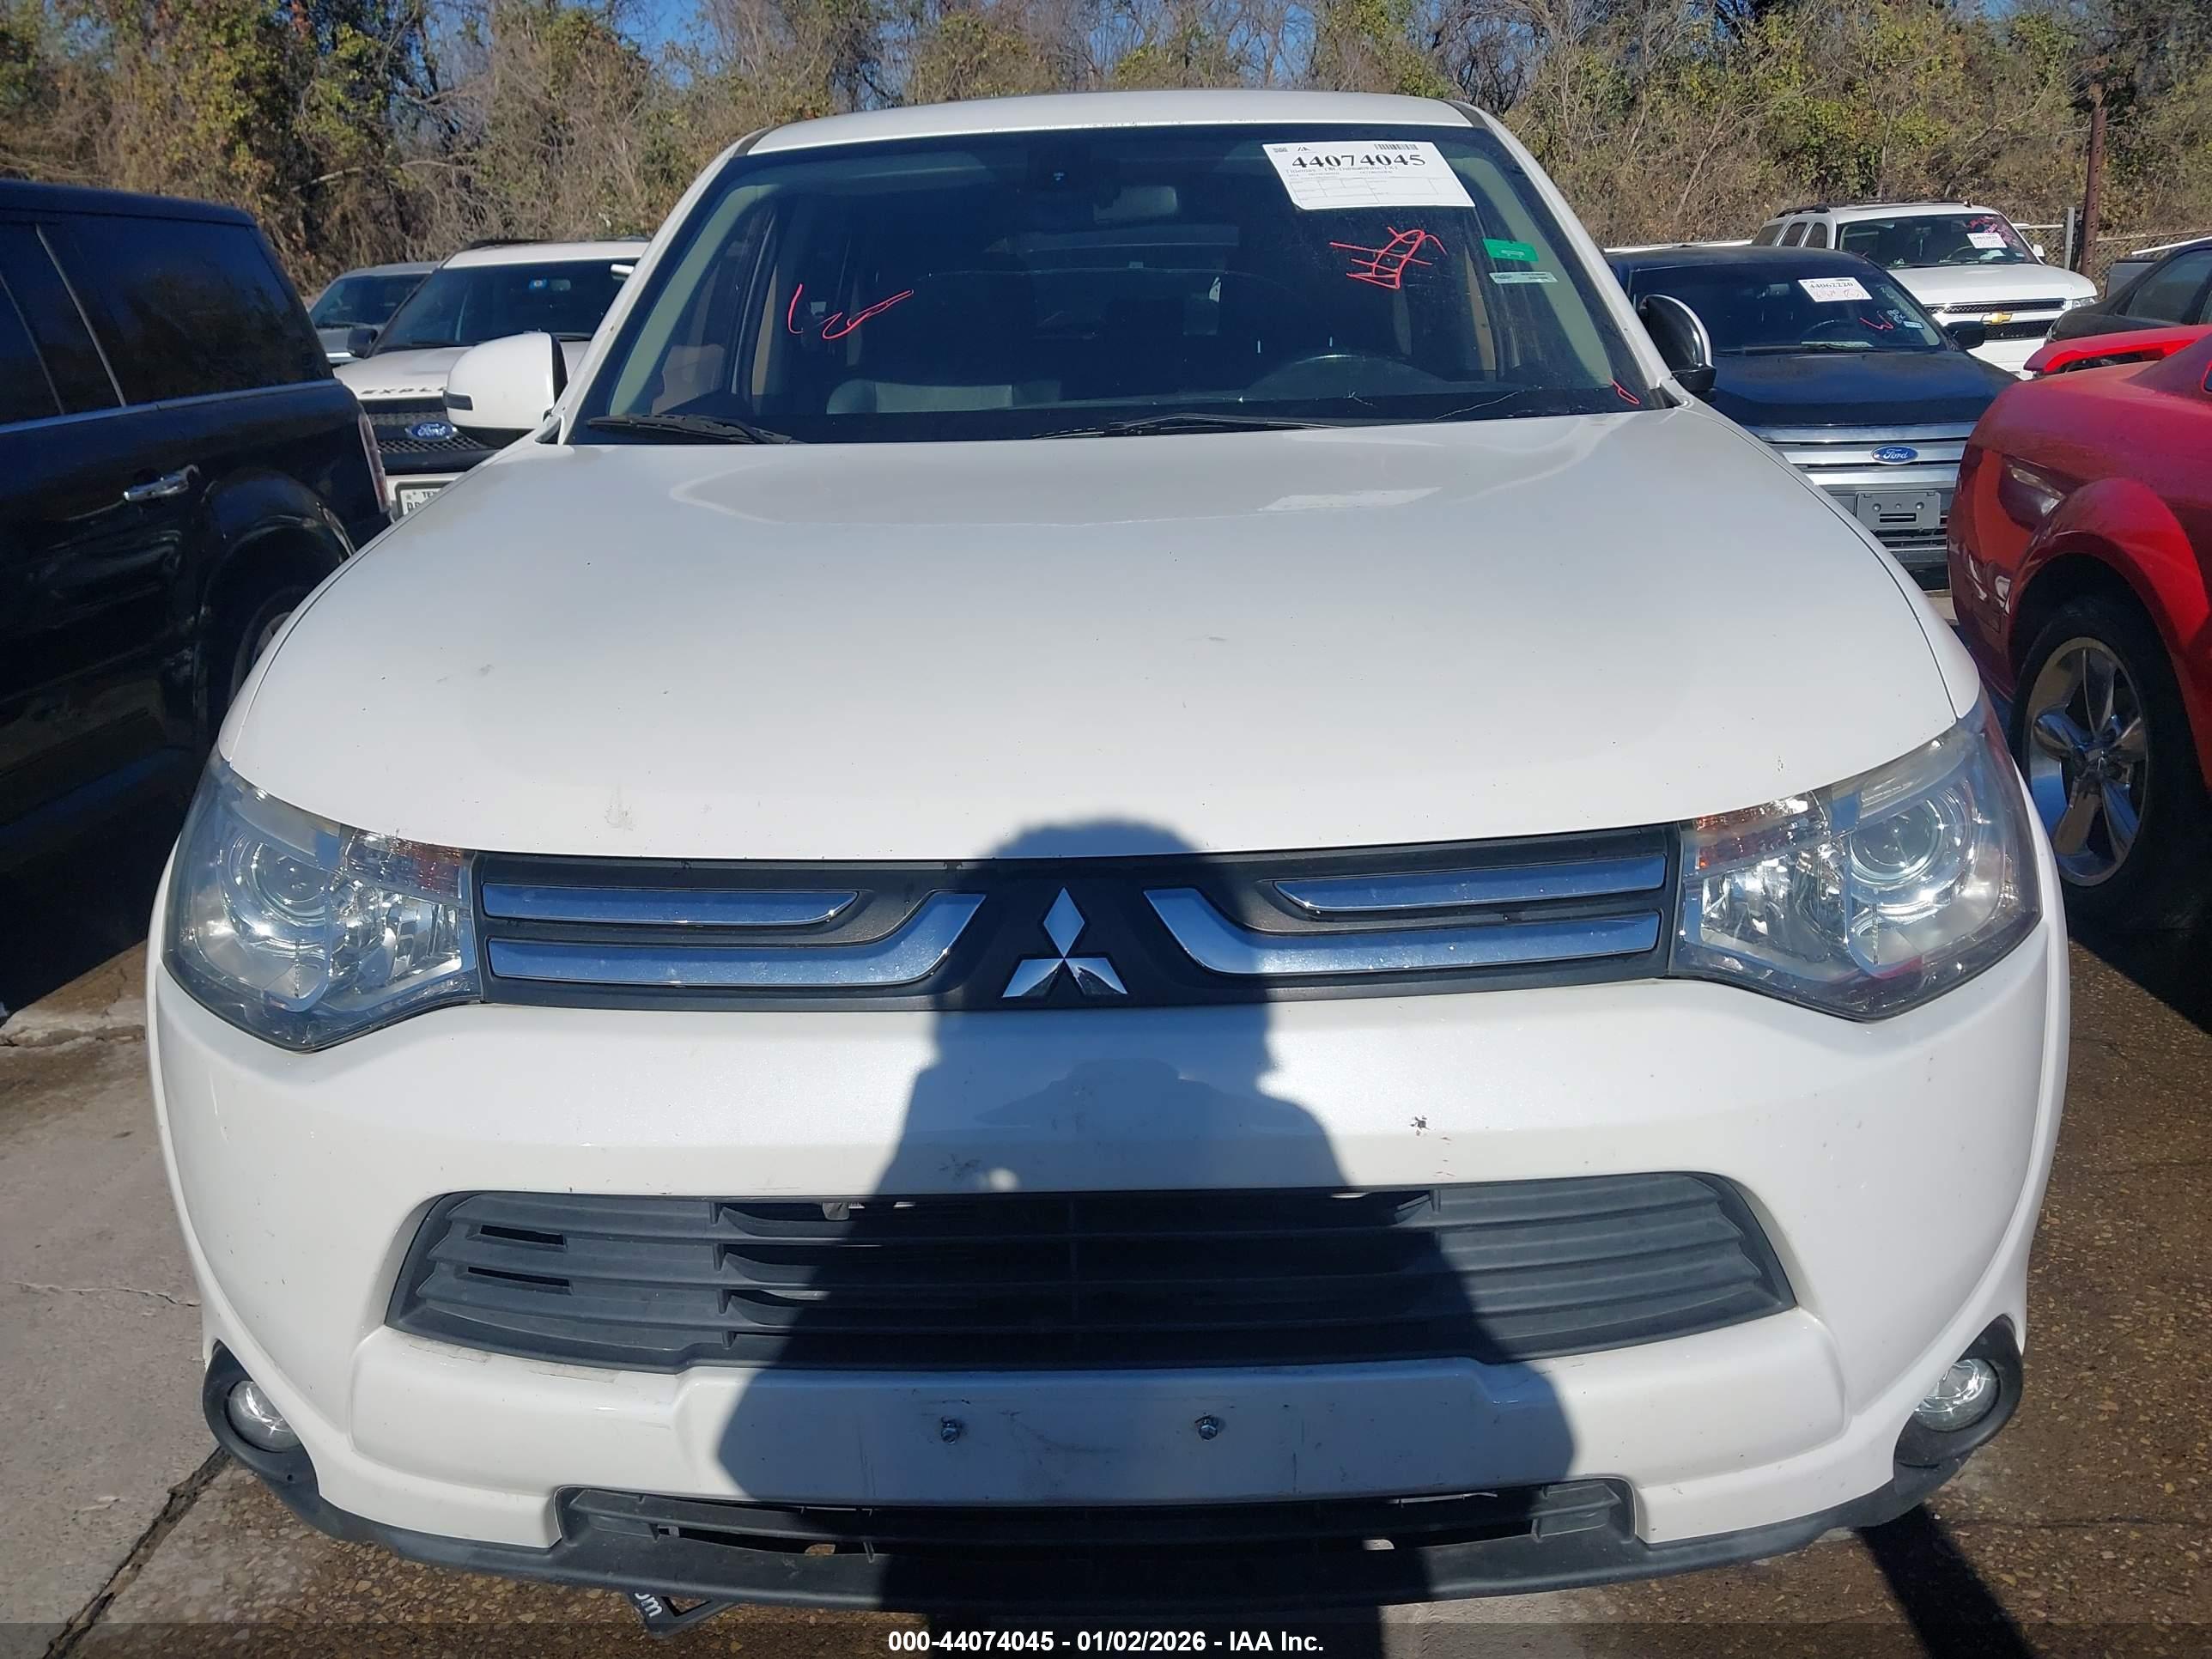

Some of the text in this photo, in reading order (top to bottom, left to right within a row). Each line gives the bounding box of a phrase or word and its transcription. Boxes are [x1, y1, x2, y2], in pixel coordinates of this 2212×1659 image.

[1291, 153, 1426, 169] 44074045
[416, 422, 447, 438] Ford
[1882, 448, 1909, 459] Ford
